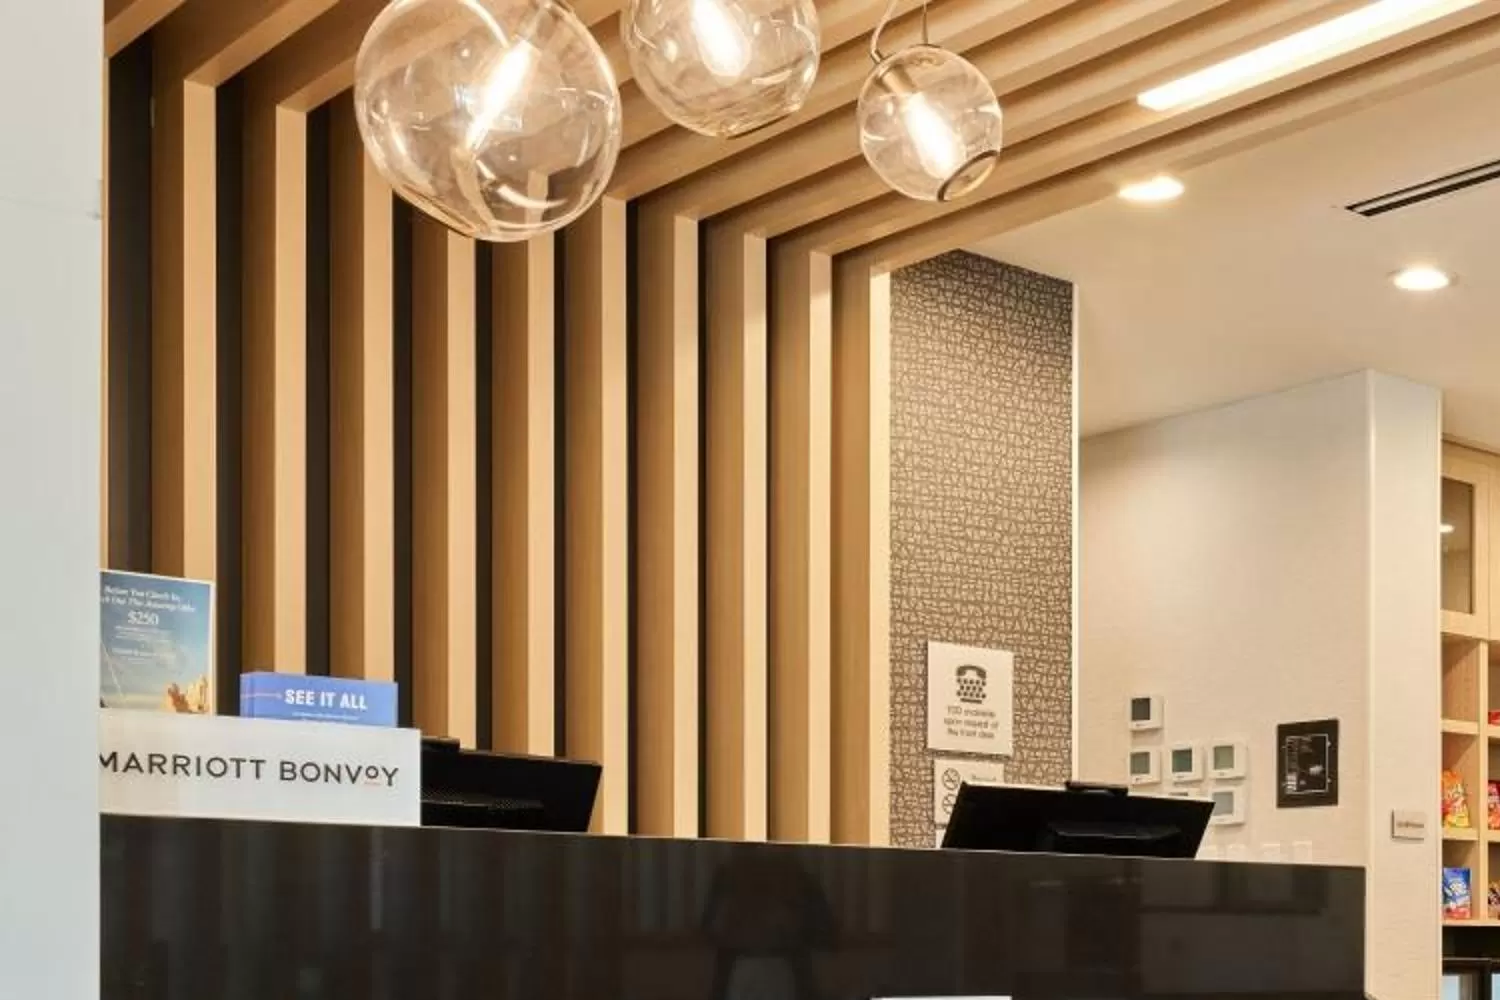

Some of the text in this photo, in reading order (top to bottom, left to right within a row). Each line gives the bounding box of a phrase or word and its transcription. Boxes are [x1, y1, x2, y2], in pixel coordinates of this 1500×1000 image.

[284, 689, 368, 710] SEE IT ALL
[99, 751, 267, 780] MARRIOTT
